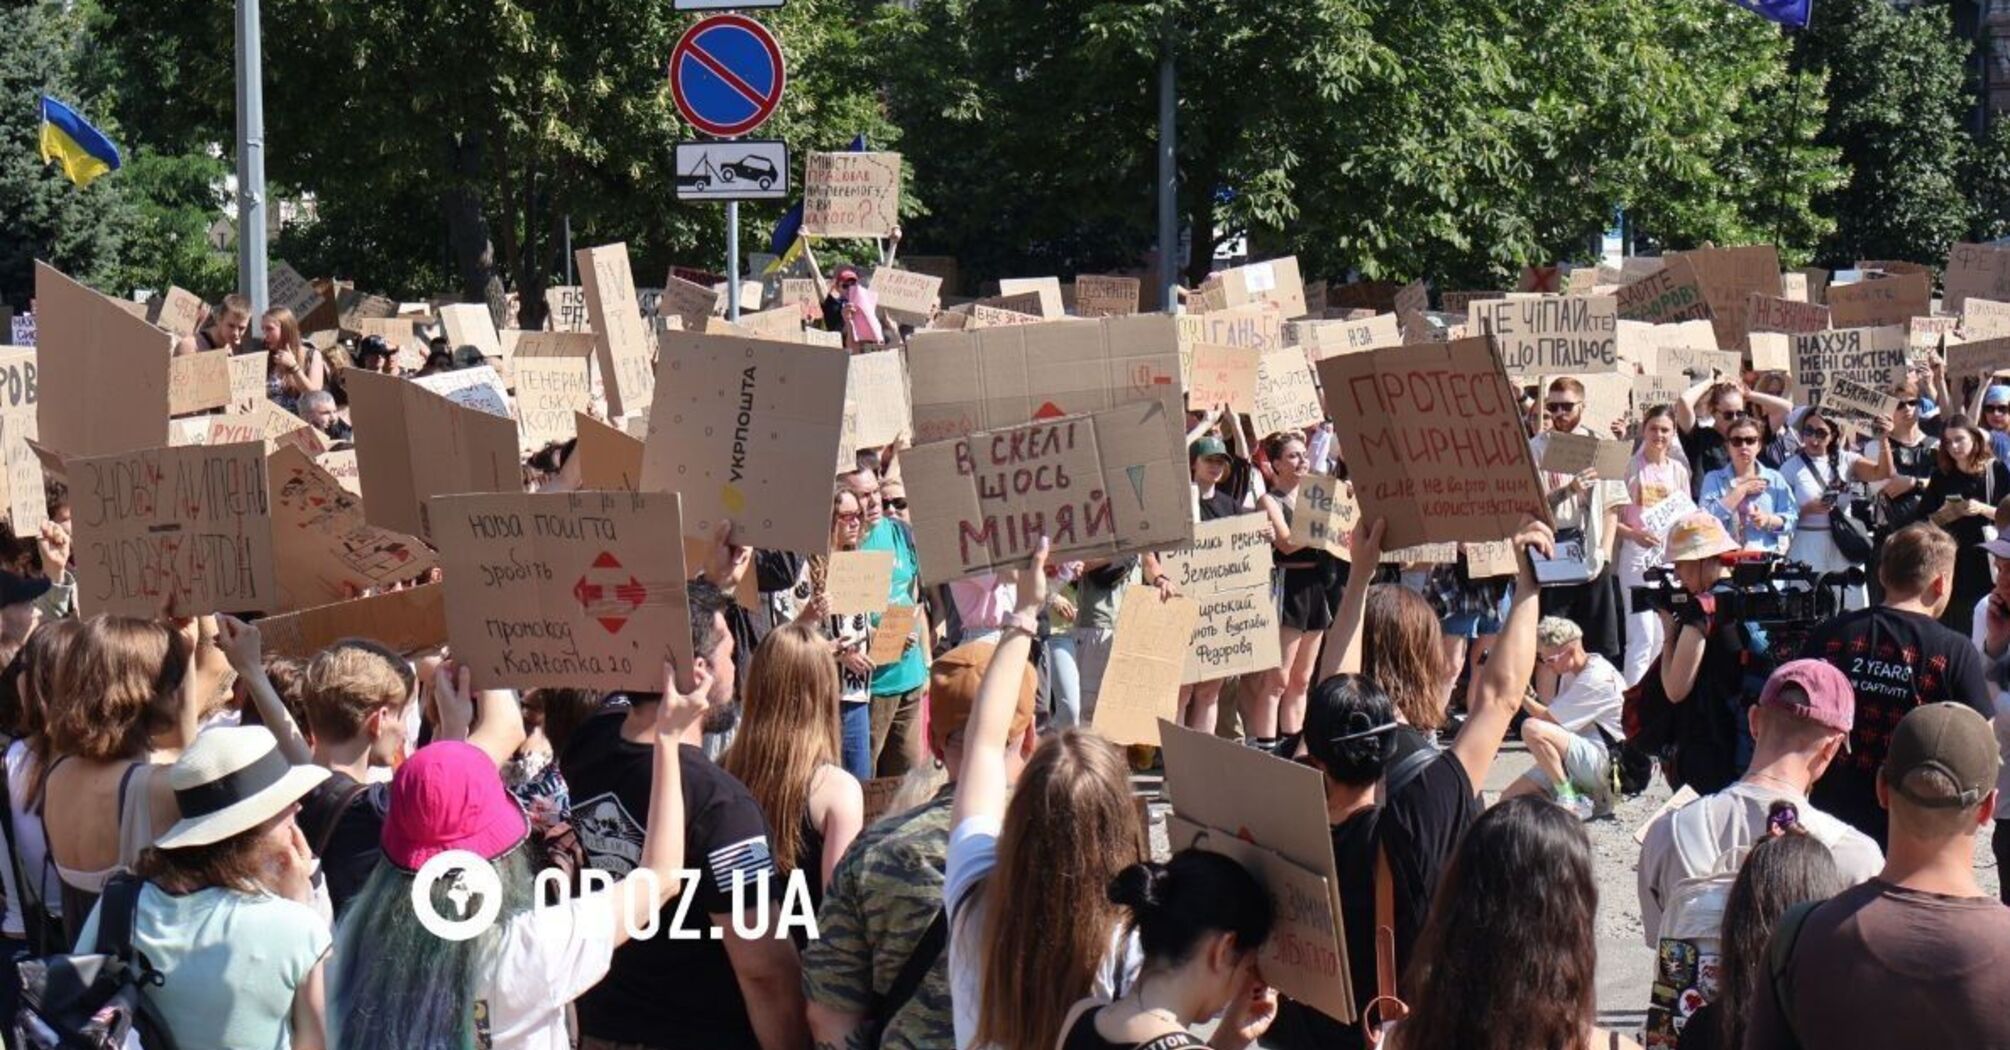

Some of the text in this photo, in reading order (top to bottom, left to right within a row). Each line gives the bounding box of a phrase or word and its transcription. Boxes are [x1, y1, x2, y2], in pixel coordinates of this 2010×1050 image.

[1476, 302, 1516, 335] НЕ
[1501, 338, 1615, 373] ЩО ПРАЦЮЄ
[1796, 331, 1860, 354] НАХУЯ
[1800, 354, 1838, 371] МЕНІ
[1842, 348, 1907, 369] СИСТЕМА
[1349, 370, 1506, 418] ПРОТЕСТ
[1800, 372, 1825, 387] ЩО
[729, 365, 758, 483] УКРПОШТА
[955, 440, 976, 477] В
[990, 423, 1076, 466] СКЕЛІ
[1358, 421, 1525, 468] МИРНИЙ
[979, 464, 1071, 501] ЩОСЬ
[1181, 555, 1252, 586] Зеленський
[1851, 657, 1913, 682] 2 YEARS
[1860, 680, 1908, 699] CAPTIVITY
